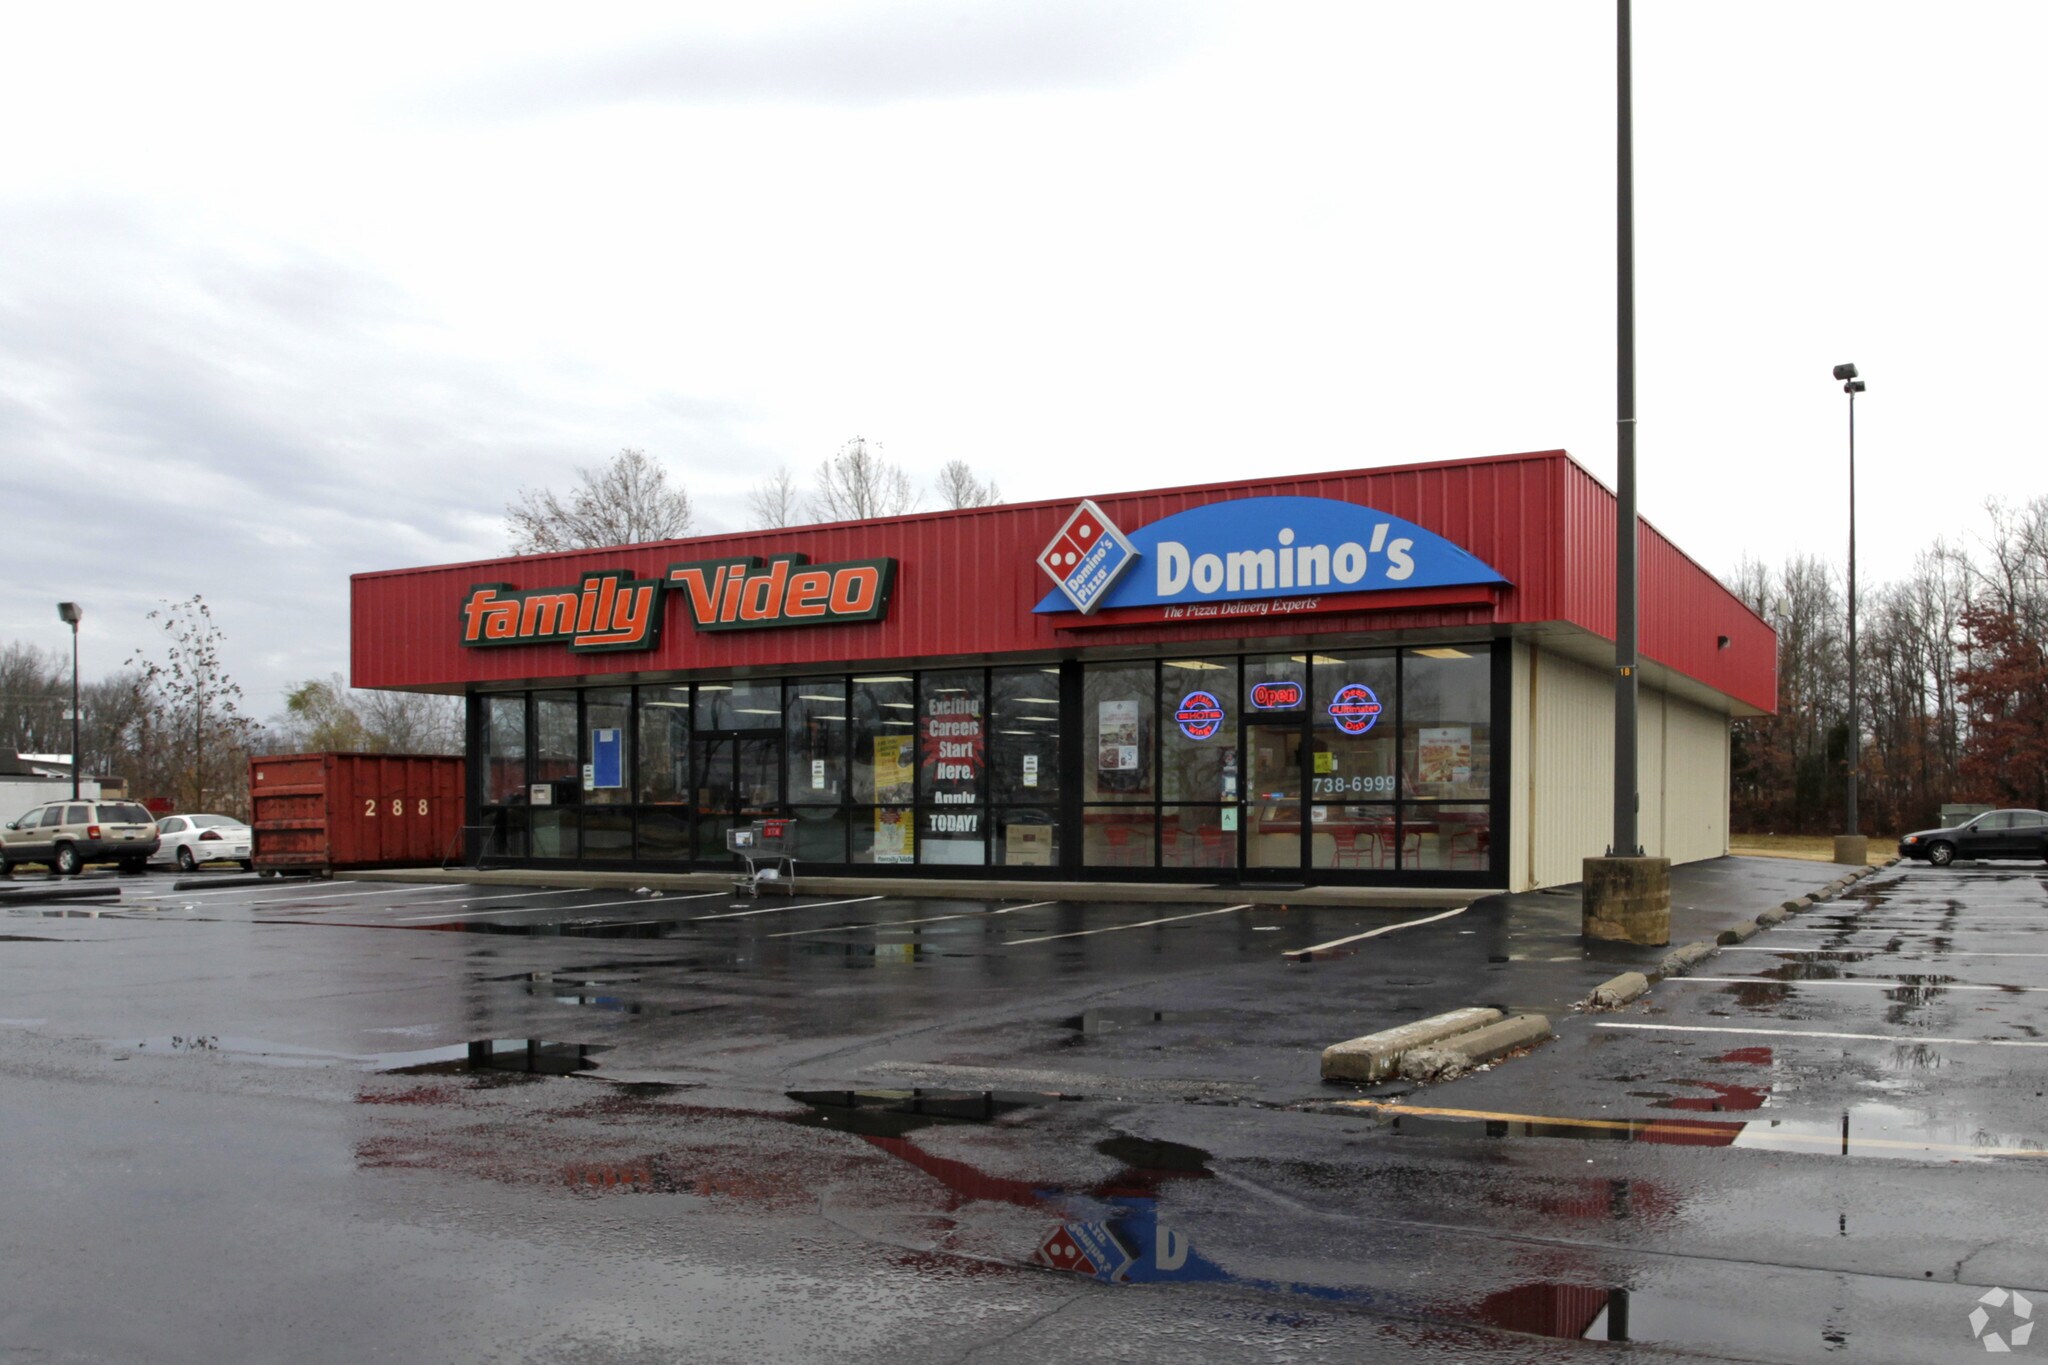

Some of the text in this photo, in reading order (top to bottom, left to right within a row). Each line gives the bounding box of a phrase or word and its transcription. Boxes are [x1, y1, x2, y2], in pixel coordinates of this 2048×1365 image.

[1067, 539, 1113, 593] Domino's
[1157, 523, 1414, 597] Domino's
[1076, 570, 1107, 603] Pizza
[465, 560, 878, 646] family Video
[1164, 599, 1318, 618] The Pizza Delivery Experts
[1185, 694, 1214, 708] Buffalo
[1255, 686, 1297, 706] Open
[1343, 689, 1367, 699] Deep
[928, 697, 980, 717] Exciting
[1190, 711, 1210, 720] HOT
[1337, 704, 1374, 714] Ultimate
[929, 720, 979, 737] Careers
[1188, 725, 1212, 736] Wings
[1345, 721, 1365, 731] Dish
[939, 741, 973, 758] Start
[937, 763, 974, 780] Here.
[1313, 776, 1395, 793] 738-6999
[935, 791, 976, 809] Apply
[929, 814, 978, 832] TODAY!
